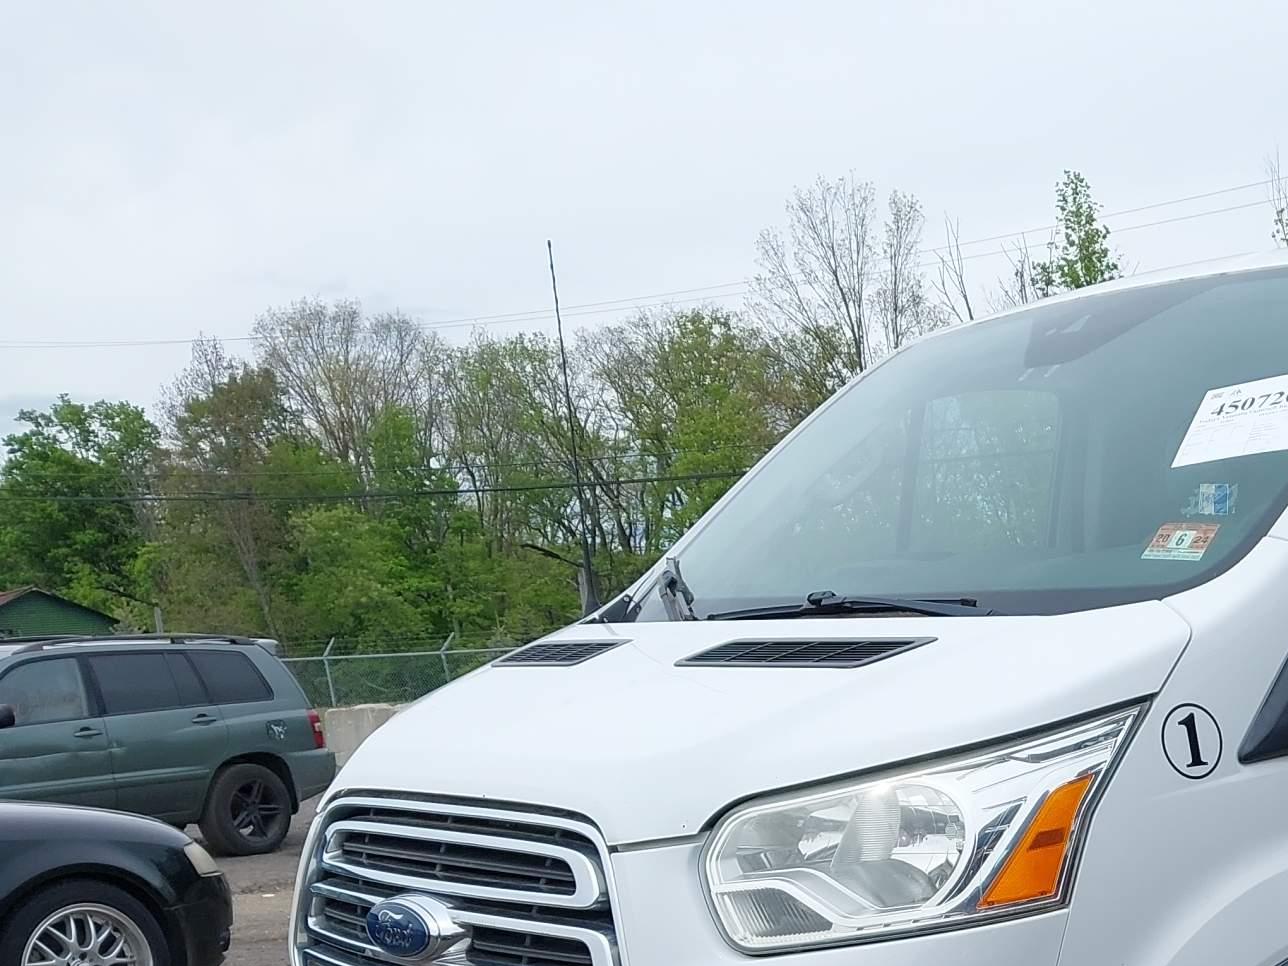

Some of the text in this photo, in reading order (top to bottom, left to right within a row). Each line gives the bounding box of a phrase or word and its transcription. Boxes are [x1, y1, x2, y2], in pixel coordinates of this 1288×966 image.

[1175, 533, 1188, 547] 6
[1177, 712, 1209, 768] 1
[375, 909, 413, 948] Ford
